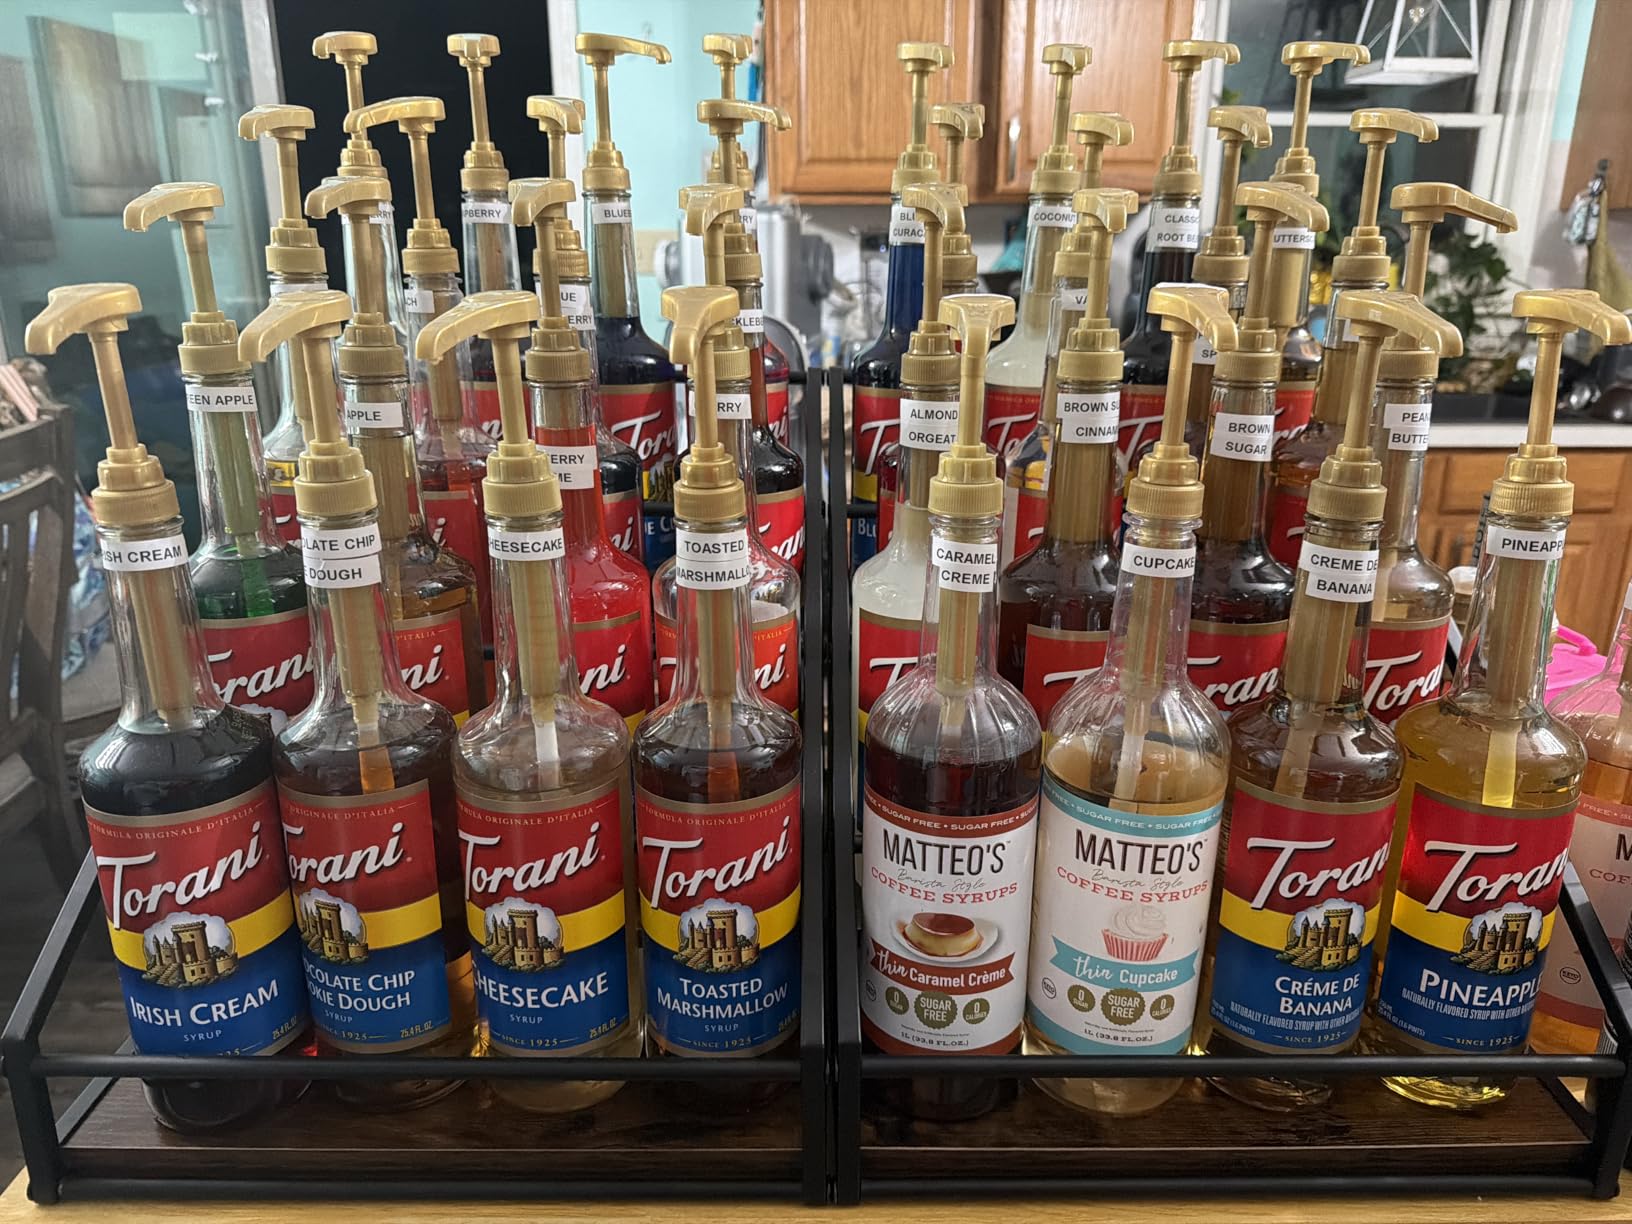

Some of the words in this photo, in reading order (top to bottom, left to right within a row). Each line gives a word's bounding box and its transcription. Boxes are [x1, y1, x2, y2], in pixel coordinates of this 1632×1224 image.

[893, 228, 924, 238] CURAC
[1157, 233, 1184, 242] ROOT
[567, 315, 593, 325] ERRY
[189, 394, 211, 405] EEN
[215, 394, 254, 406] APPLE
[717, 402, 742, 413] RRY
[1064, 401, 1109, 414] BROWN
[910, 408, 958, 421] ALMOND
[1228, 422, 1271, 435] BROWN
[908, 431, 957, 444] ORGEAT
[1225, 441, 1267, 456] SUGAR
[550, 454, 585, 465] ERRY
[344, 535, 375, 550] CHIP
[684, 539, 745, 554] TOASTED
[1501, 537, 1564, 553] PINEAPP
[127, 545, 182, 564] CREAM
[936, 547, 996, 565] CARAMEL
[1133, 554, 1195, 570] CUPCAKE
[1310, 553, 1363, 572] CREME
[309, 567, 363, 581] DOUGH
[940, 569, 990, 585] CREME
[1316, 579, 1373, 596] BANANA
[344, 806, 395, 820] D'ITALIA
[485, 814, 543, 826] ORIGINALE
[547, 806, 594, 824] D'ITALIA
[881, 805, 911, 822] SUGAR
[912, 817, 941, 829] FREE
[950, 822, 988, 831] SUGAR
[990, 816, 1015, 828] FREE
[1076, 806, 1112, 822] SUGAR
[1114, 818, 1145, 830] FREE
[1154, 821, 1192, 831] SUGAR
[135, 825, 203, 840] ORIGINALE
[206, 807, 255, 831] D'ITALIA
[686, 815, 745, 827] ORIGINALE
[882, 828, 1007, 876] MATTEO'S
[1075, 828, 1204, 876] MATTEO'S
[458, 821, 600, 901] Torani
[642, 815, 790, 909] Torani
[96, 821, 263, 929] Torani
[871, 866, 936, 903] COFFEE
[942, 881, 1018, 904] SYRUPS
[1056, 866, 1134, 902] COFFEE
[1139, 880, 1208, 903] SYRUPS
[876, 950, 909, 977] thin
[909, 967, 965, 988] Caramel
[968, 967, 1006, 987] Crème
[1073, 955, 1113, 981] thin
[1119, 968, 1178, 988] Cupcake
[368, 970, 416, 991] CHIP
[679, 977, 763, 999] TOASTED
[1342, 973, 1361, 993] DE
[130, 996, 183, 1027] IRISH
[189, 979, 279, 1025] CREAM
[338, 992, 411, 1012] DOUGH
[657, 982, 788, 1019] MARSHMALLOW
[920, 996, 952, 1011] SUGAR
[1107, 994, 1140, 1009] SUGAR
[1279, 997, 1352, 1017] BANANA
[324, 1009, 353, 1024] SYRUP
[923, 1009, 948, 1022] FREE
[1110, 1006, 1136, 1019] FREE
[1436, 1002, 1470, 1019] FLAVORED
[1470, 1006, 1491, 1021] SYRUP
[1490, 1008, 1505, 1020] WITH
[510, 1014, 543, 1025] SYRUP
[1262, 1014, 1295, 1030] FLAVORED
[1294, 1019, 1315, 1032] SYRUP
[1315, 1018, 1329, 1031] WITH
[341, 1030, 367, 1041] 1925
[704, 1023, 739, 1033] SYRUP
[183, 1030, 223, 1042] SYRUP
[529, 1038, 559, 1047] 1925
[724, 1037, 752, 1049] 1925
[1284, 1035, 1312, 1043] SINCE
[1317, 1031, 1341, 1043] 1925
[1456, 1037, 1485, 1047] SINCE
[1489, 1035, 1513, 1047] 1925
